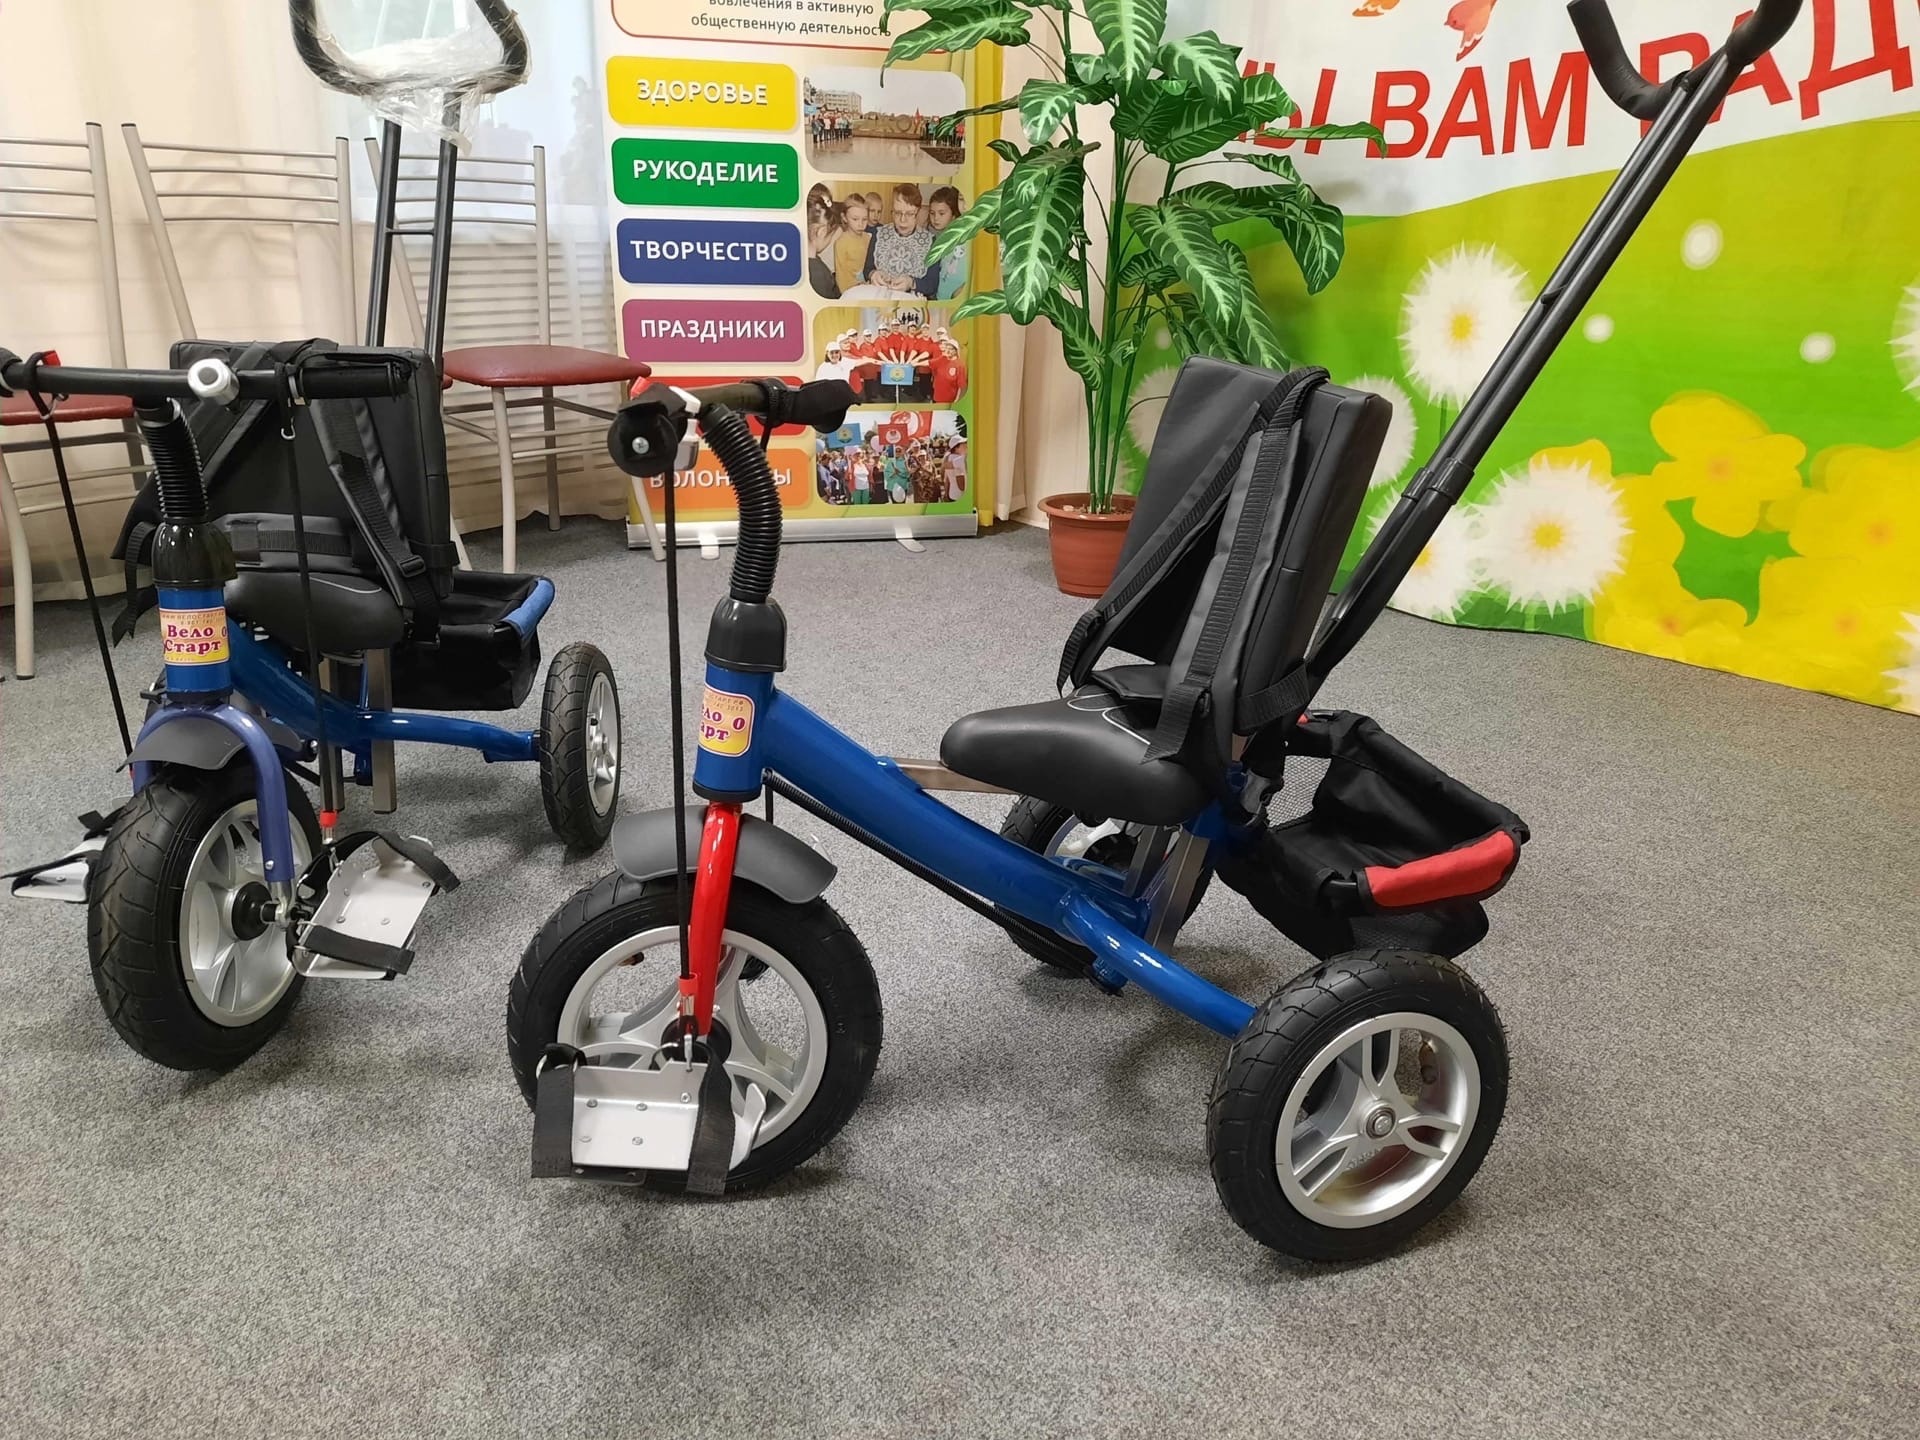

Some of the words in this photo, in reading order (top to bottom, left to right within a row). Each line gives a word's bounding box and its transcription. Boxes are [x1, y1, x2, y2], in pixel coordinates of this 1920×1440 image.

[796, 1, 804, 10] в
[807, 1, 874, 18] активную
[691, 13, 797, 35] общественную
[1366, 51, 1591, 159] ВАМ
[1639, 0, 1920, 139] РАД
[637, 78, 768, 107] ЗДОРОВЬЕ
[633, 159, 779, 186] РУКОДЕЛИЕ
[630, 240, 788, 262] ТВОРЧЕСТВО
[641, 319, 785, 344] ПРАЗДНИКИ
[167, 624, 214, 638] Вело
[164, 639, 221, 655] Старт
